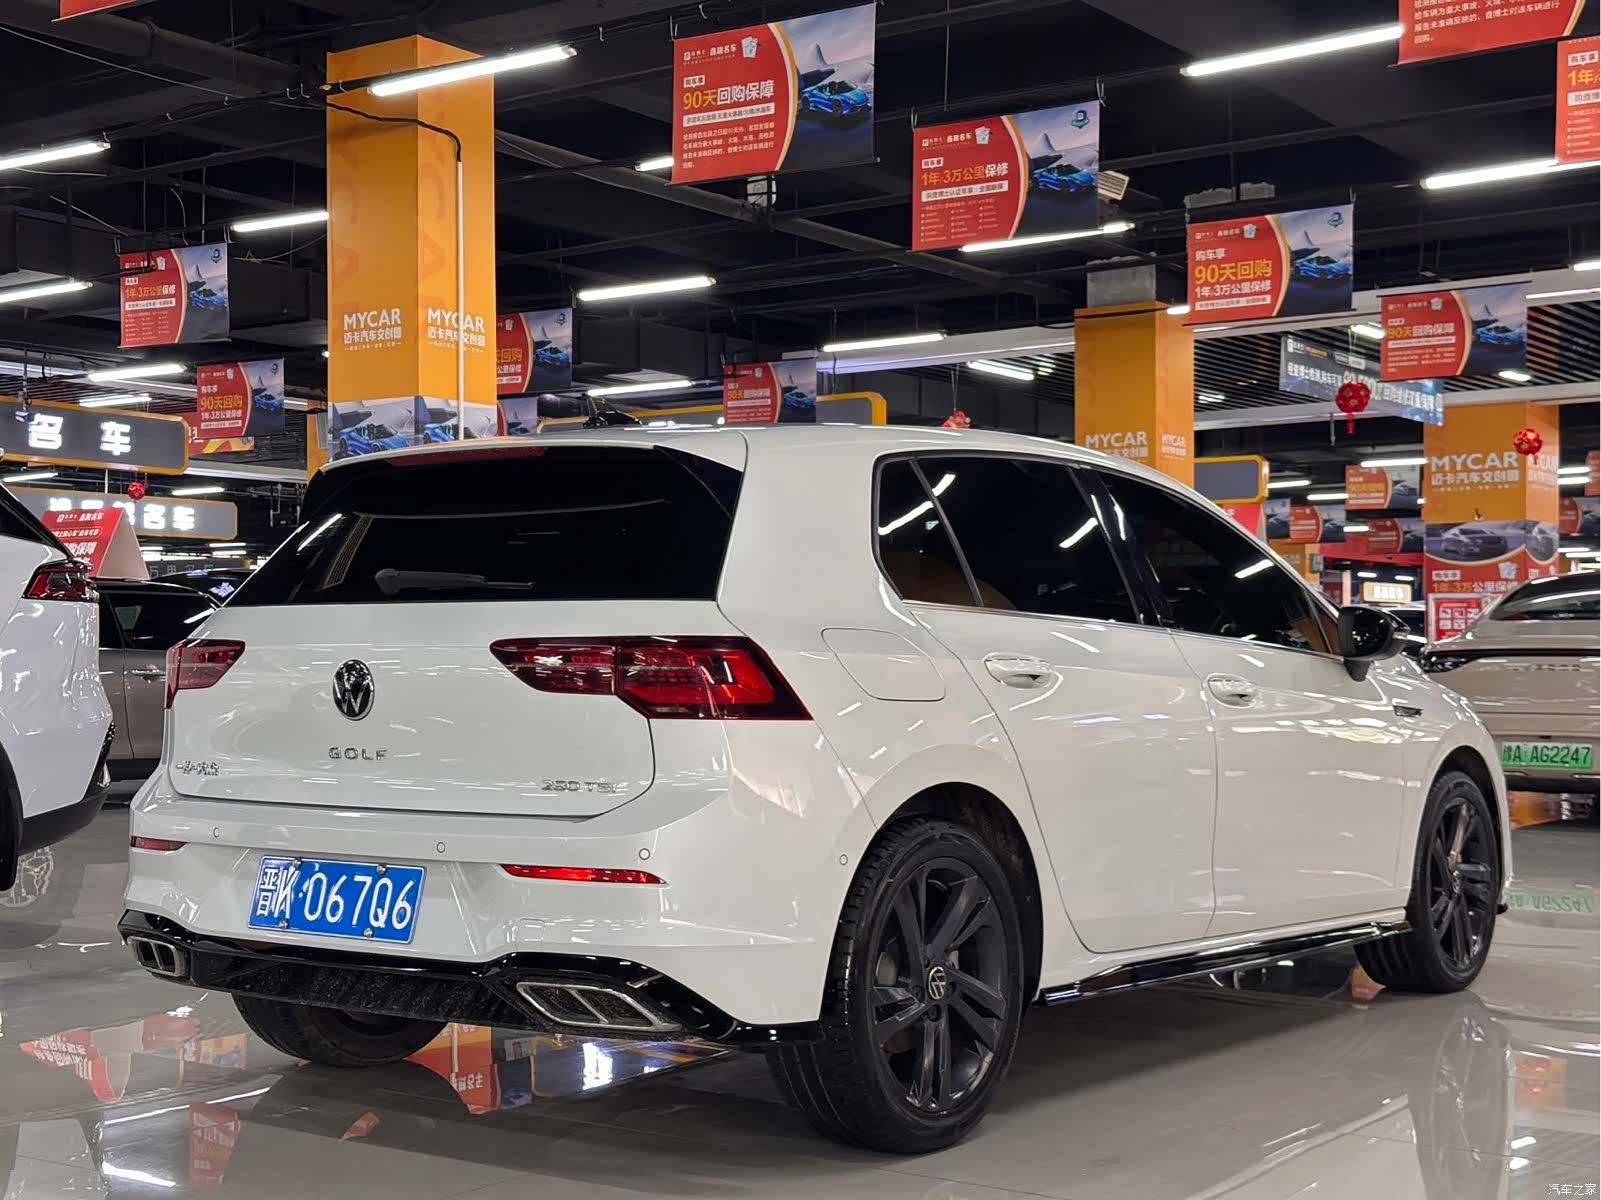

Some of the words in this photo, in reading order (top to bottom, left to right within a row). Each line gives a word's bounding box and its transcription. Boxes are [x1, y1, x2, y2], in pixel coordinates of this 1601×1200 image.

[683, 80, 775, 110] 90天回购保障
[922, 162, 1009, 186] 1年/3万公里保修
[1195, 248, 1226, 262] 购车享
[1195, 259, 1272, 284] 90天回购
[344, 307, 401, 331] MYCAR
[428, 307, 485, 334] MYCAR
[344, 326, 402, 344] 迈卡汽车文创园
[201, 394, 243, 410] 90天回购
[1085, 431, 1148, 449] MYCAR
[1431, 451, 1519, 472] MYCAR
[328, 747, 388, 760] GOLF
[1530, 745, 1591, 764] AG2247
